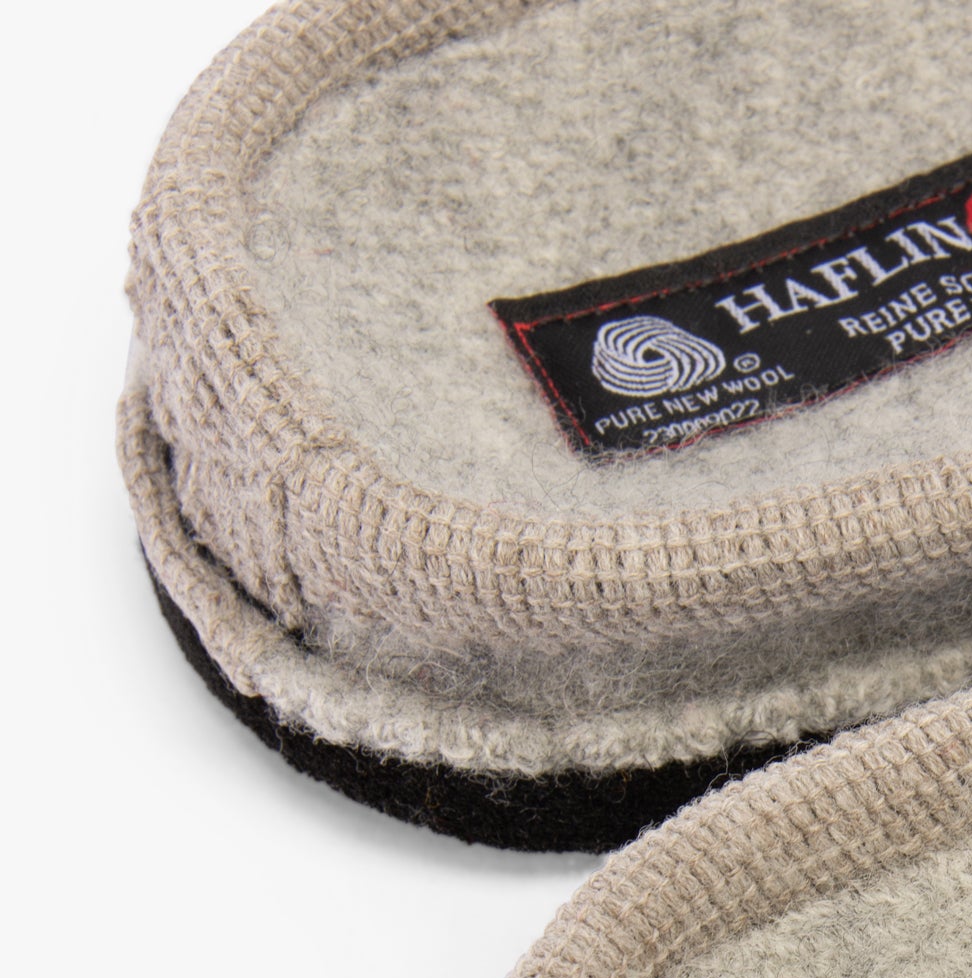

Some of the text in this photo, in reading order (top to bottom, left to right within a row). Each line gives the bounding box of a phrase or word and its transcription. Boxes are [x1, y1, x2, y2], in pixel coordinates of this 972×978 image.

[838, 283, 938, 337] REINE
[886, 299, 972, 354] PURE
[595, 364, 795, 435] PURE NEW WOOL
